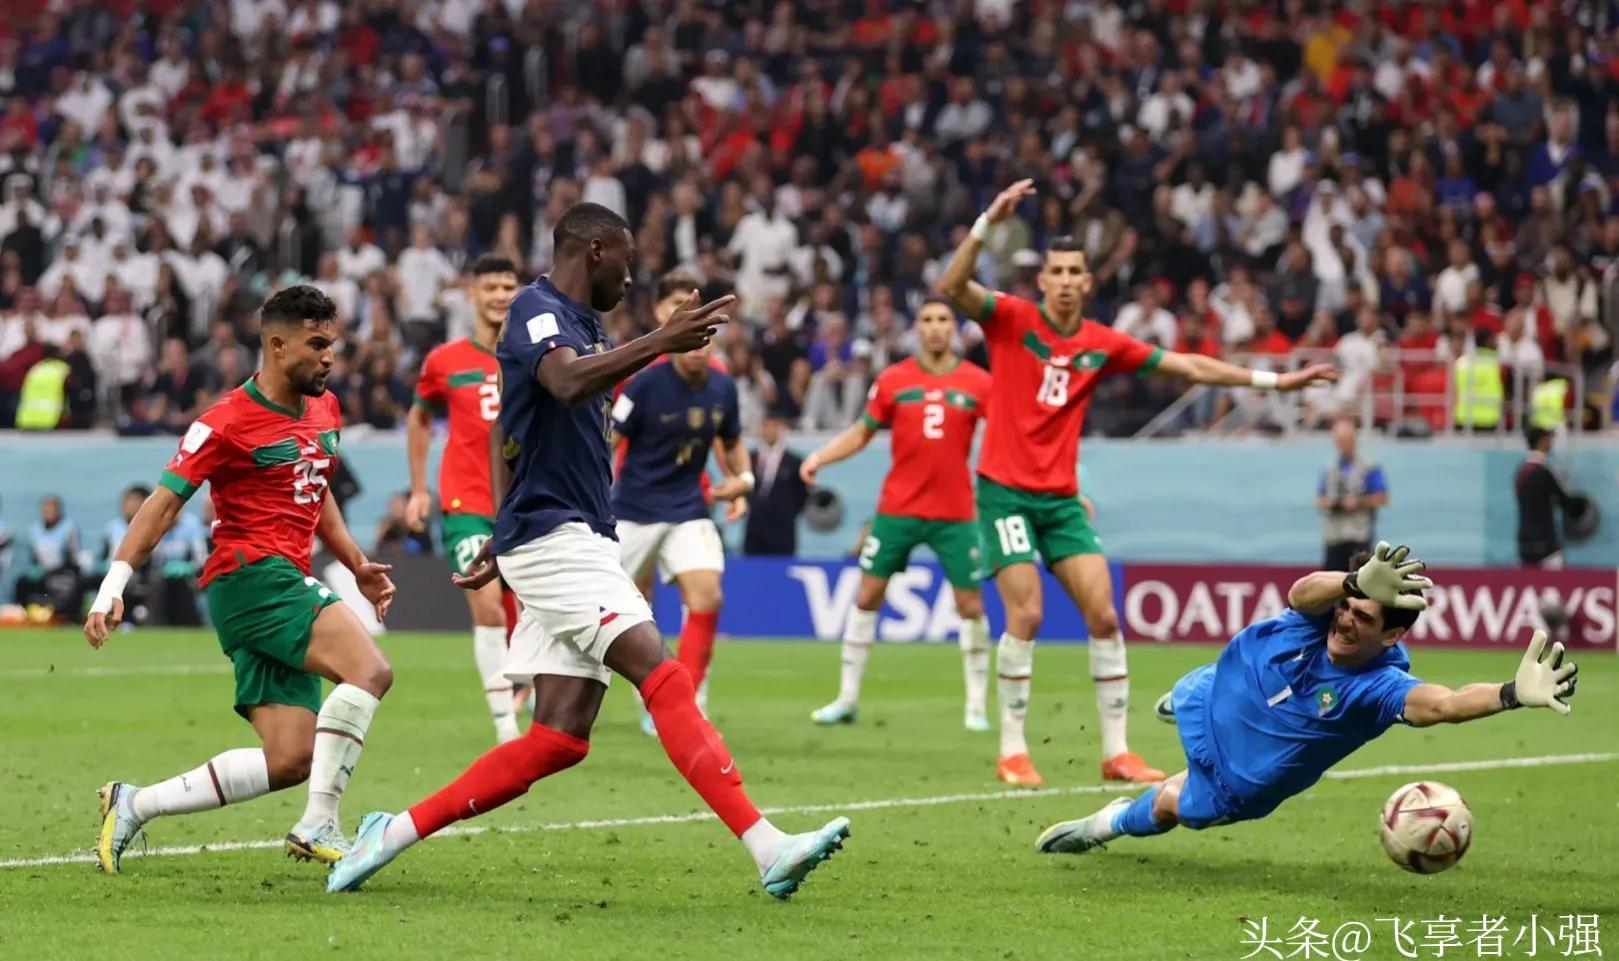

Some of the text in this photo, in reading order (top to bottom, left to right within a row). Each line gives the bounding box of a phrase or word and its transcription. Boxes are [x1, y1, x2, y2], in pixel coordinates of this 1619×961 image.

[478, 384, 501, 420] 2
[1036, 365, 1071, 407] 18
[923, 403, 945, 439] 2
[293, 458, 331, 505] 25
[858, 535, 881, 570] 2
[994, 515, 1032, 556] 18
[785, 565, 961, 642] VSA
[1124, 579, 1616, 643] QATA RWAYS
